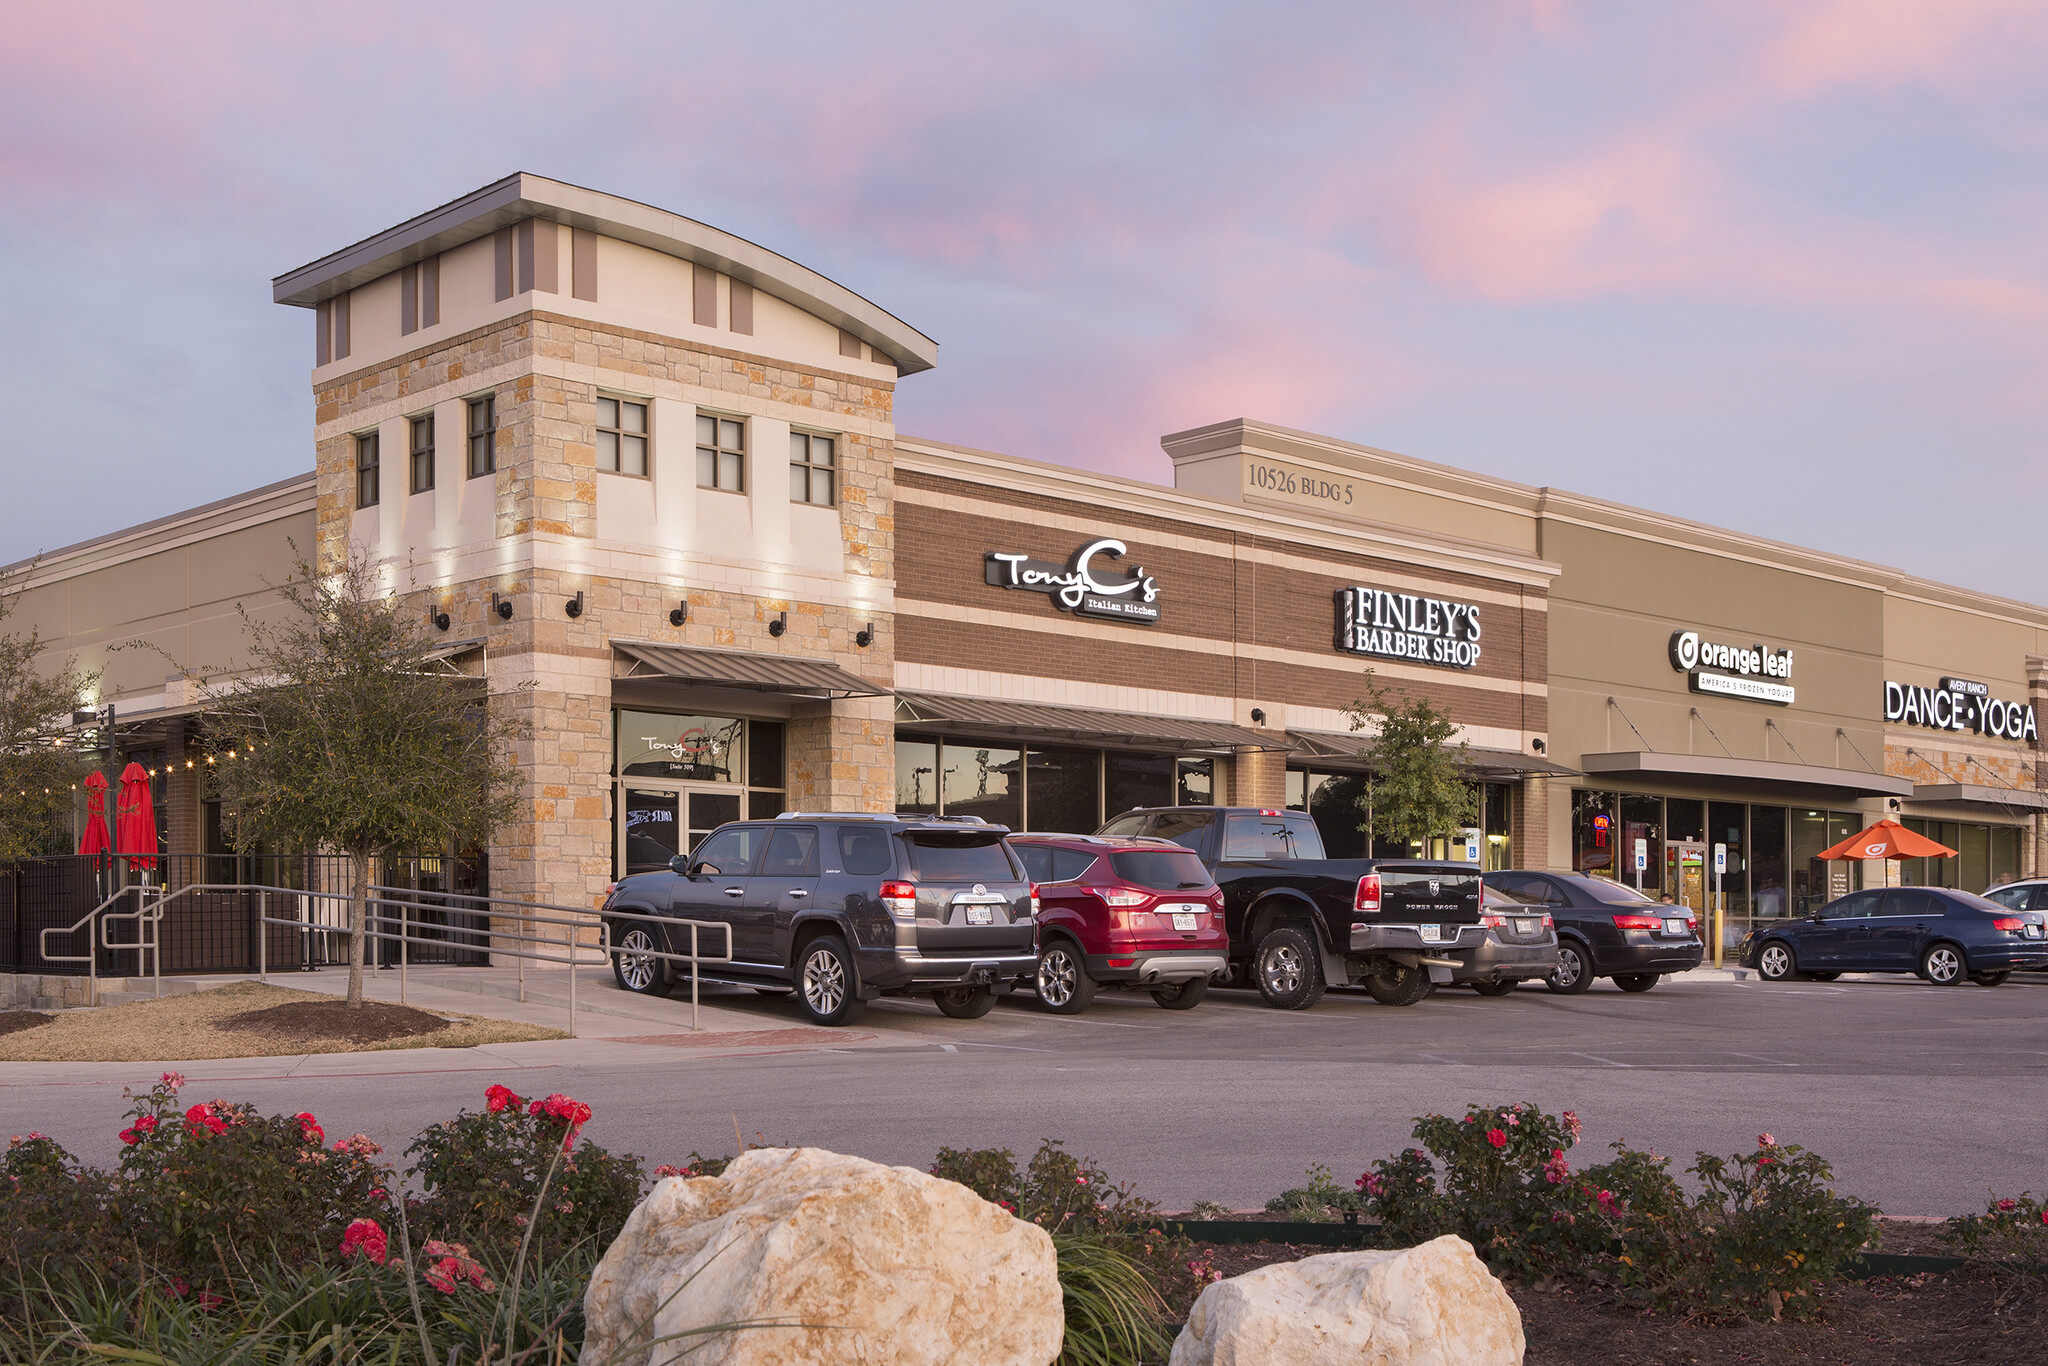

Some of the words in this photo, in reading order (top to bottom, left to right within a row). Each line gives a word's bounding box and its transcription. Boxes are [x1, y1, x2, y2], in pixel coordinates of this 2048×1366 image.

[1249, 463, 1296, 494] 10526
[1301, 476, 1341, 501] BLDG
[1344, 484, 1353, 505] 5
[994, 552, 1092, 607] Tony
[1088, 599, 1121, 612] Italian
[1124, 604, 1158, 617] Kitchen
[1355, 586, 1481, 641] FINLEY'S
[1356, 626, 1431, 660] BARBER
[1433, 637, 1481, 666] SHOP
[1700, 641, 1761, 675] orange
[1762, 645, 1793, 678] leaf
[1701, 677, 1738, 690] AMERICA'S
[1739, 683, 1765, 694] FROZEN
[1767, 687, 1793, 699] YOGURT
[1949, 679, 1967, 692] AVERY
[1967, 682, 1987, 695] RANCH
[1886, 681, 1965, 729] DANCE
[1975, 695, 2038, 741] YOGA
[640, 736, 686, 758] Tony
[1594, 816, 1608, 828] OPEN
